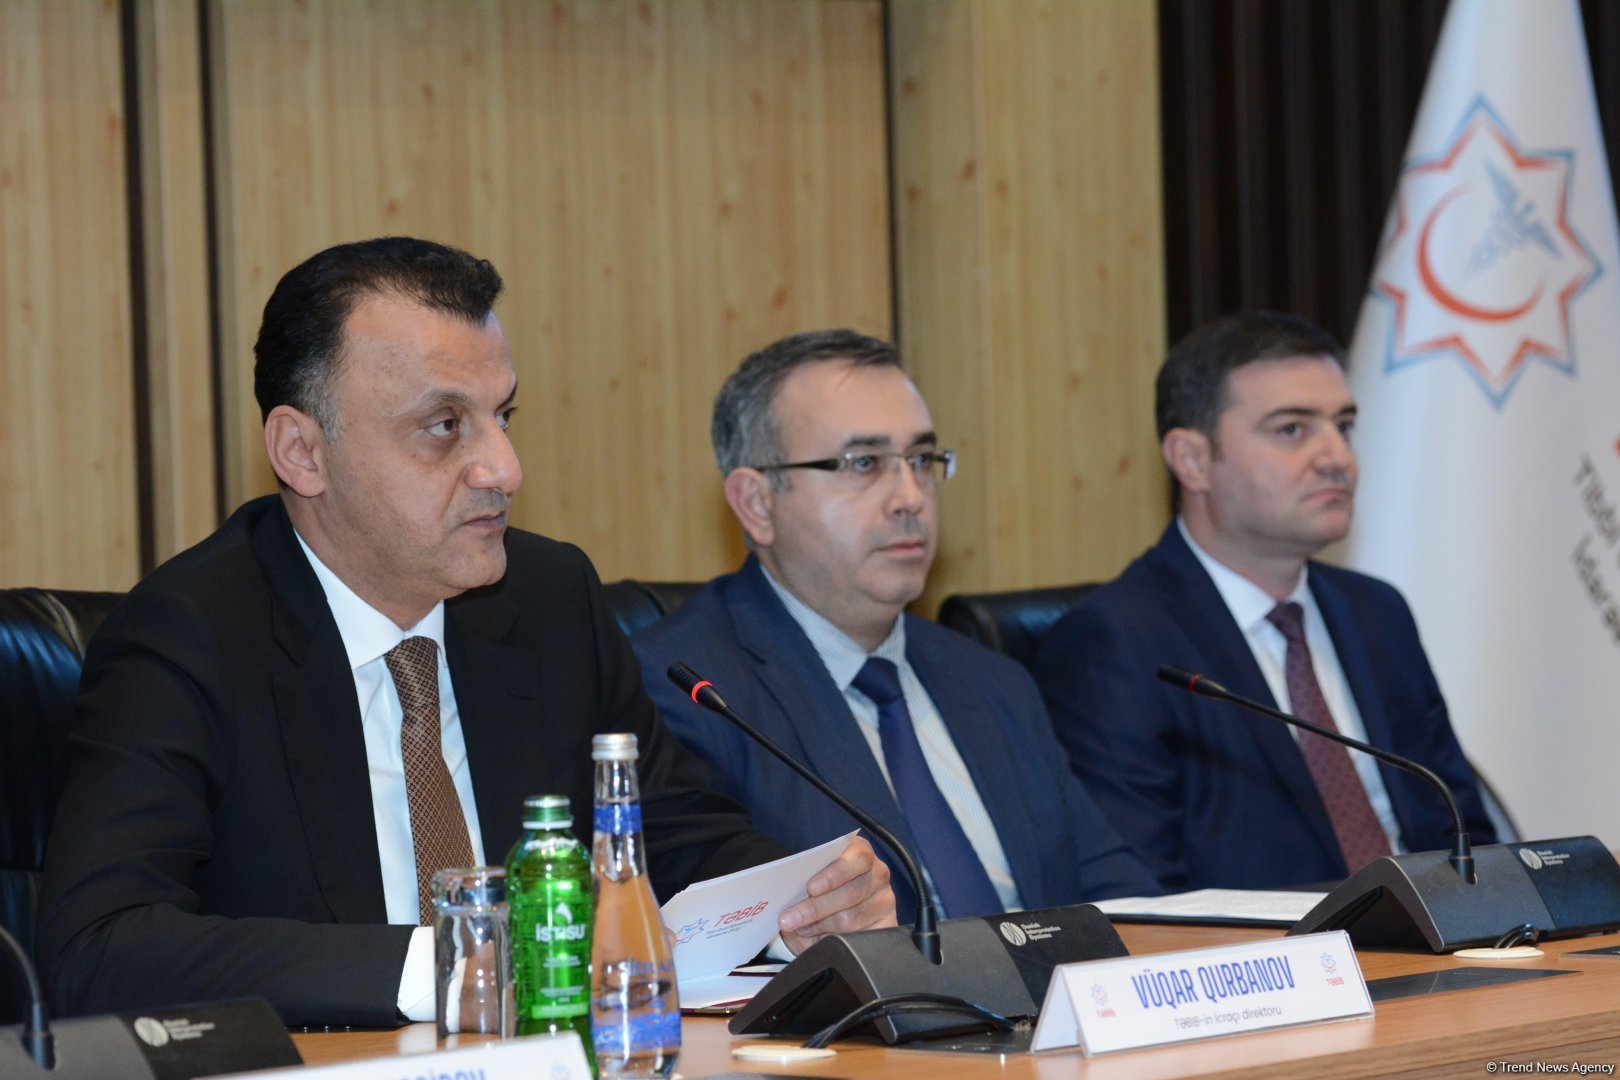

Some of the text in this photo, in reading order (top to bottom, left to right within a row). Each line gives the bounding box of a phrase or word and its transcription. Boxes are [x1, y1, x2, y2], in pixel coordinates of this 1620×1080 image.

[1131, 954, 1295, 1009] VÜQAR QURBANOV
[1242, 1005, 1282, 1021] direktoru
